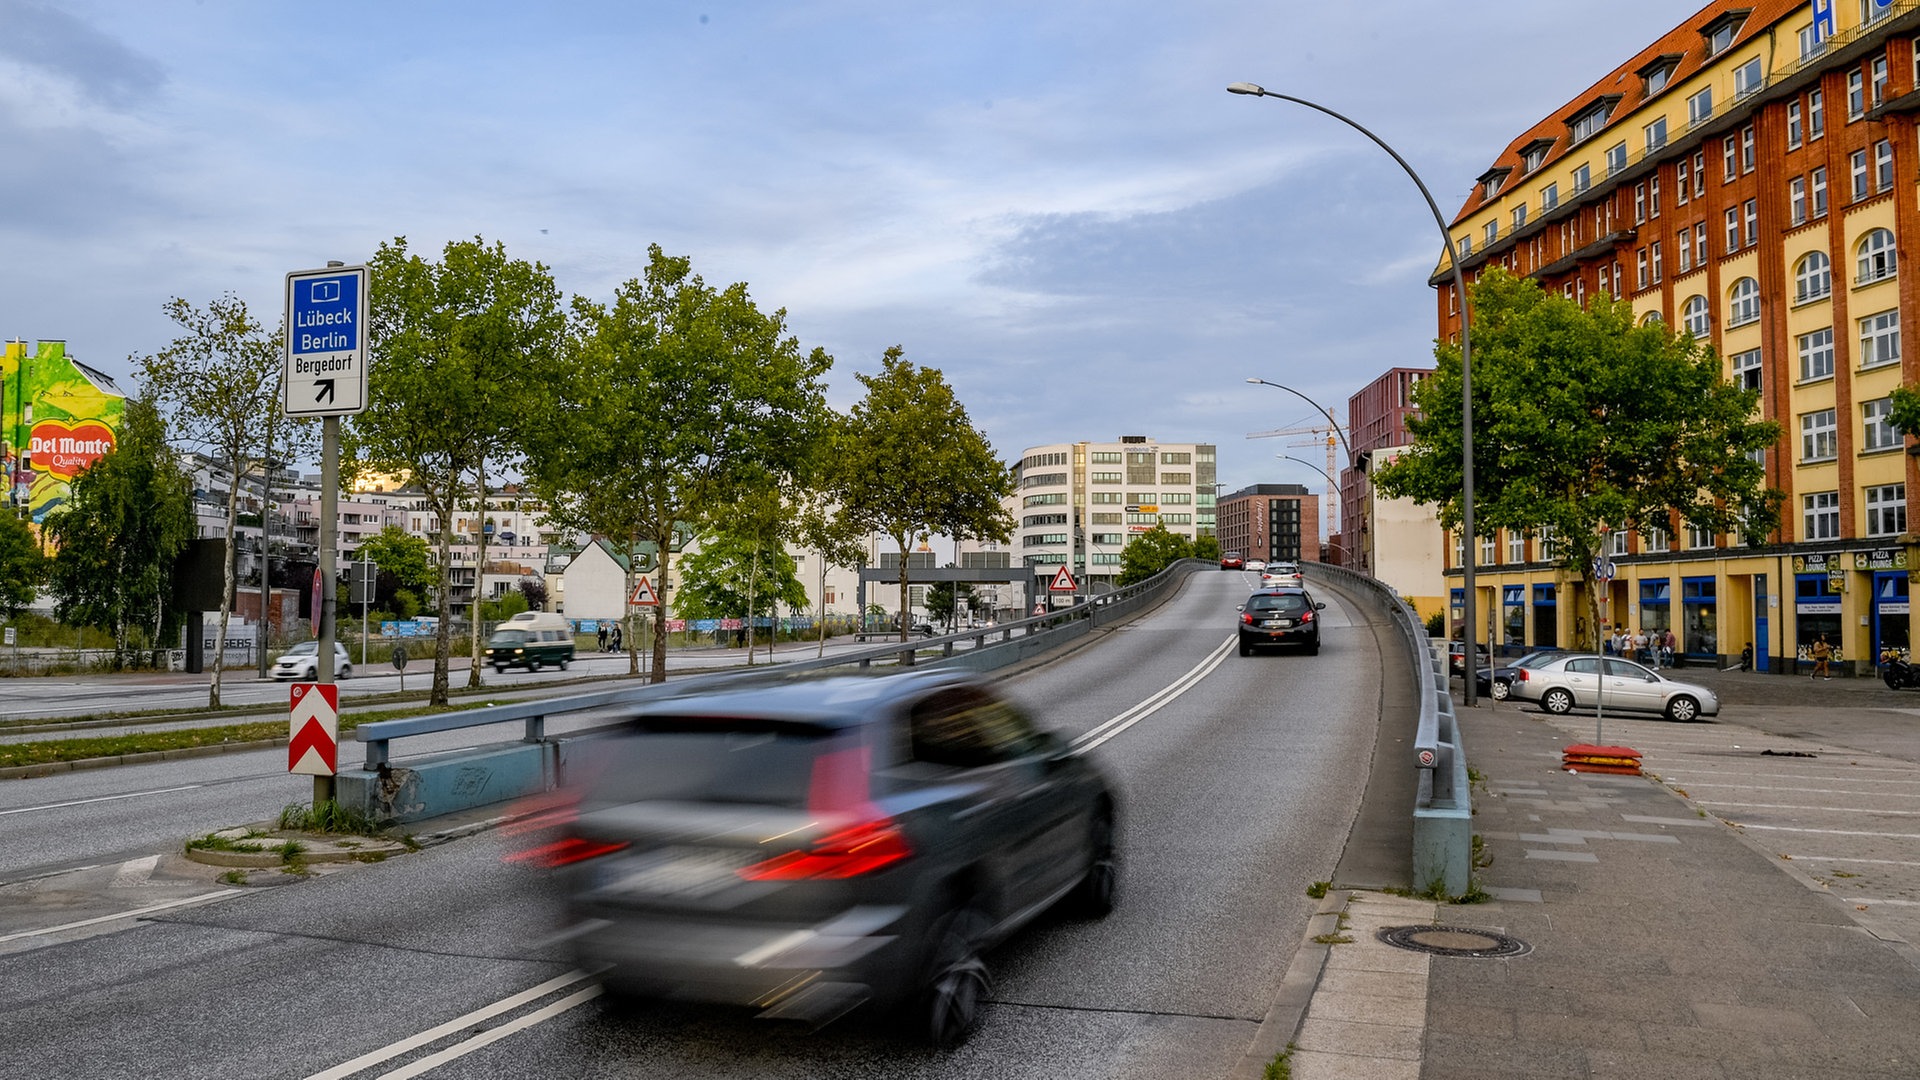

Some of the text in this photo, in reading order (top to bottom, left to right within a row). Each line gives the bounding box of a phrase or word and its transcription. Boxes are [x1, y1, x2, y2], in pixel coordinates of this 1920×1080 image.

[323, 285, 329, 298] 1
[297, 307, 352, 328] Lübeck
[302, 331, 348, 350] Berlin
[296, 354, 353, 376] Bergedorf
[31, 436, 57, 453] Del
[52, 454, 87, 468] Quality
[1808, 555, 1824, 563] PIZZA
[1872, 551, 1889, 559] PIZZA
[1805, 563, 1827, 572] LOUNGE
[1869, 559, 1893, 569] LOUNGE
